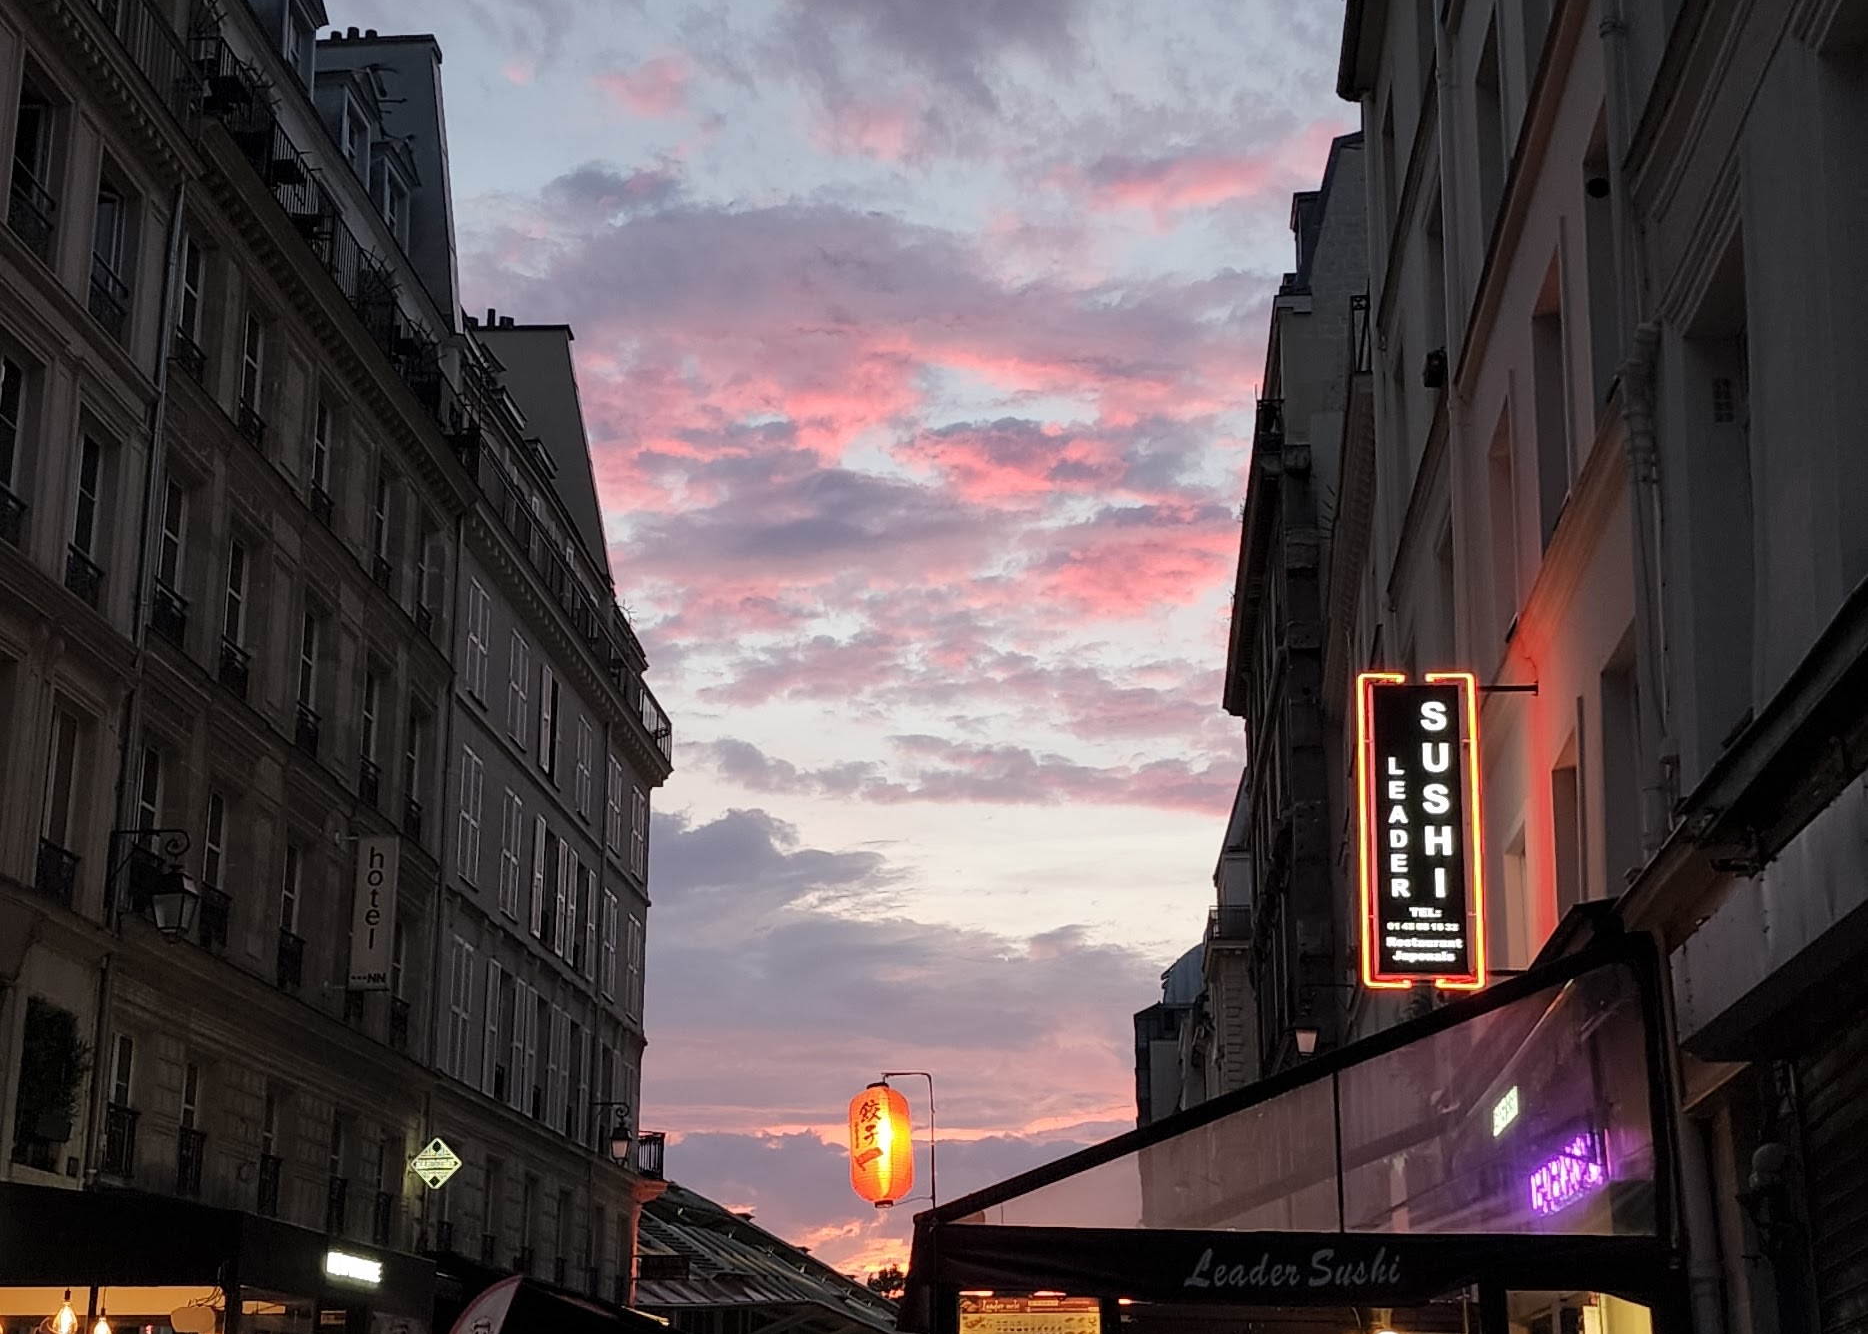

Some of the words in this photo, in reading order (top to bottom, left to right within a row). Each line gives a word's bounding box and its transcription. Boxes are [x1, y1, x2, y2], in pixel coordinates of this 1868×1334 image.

[1388, 757, 1411, 898] LEADER
[1420, 701, 1454, 899] SUSHI
[365, 846, 386, 950] hotel
[1386, 936, 1463, 948] Restaurant
[1392, 950, 1456, 963] Japonais
[1183, 1247, 1301, 1288] Leader
[1307, 1245, 1401, 1288] Sushi
